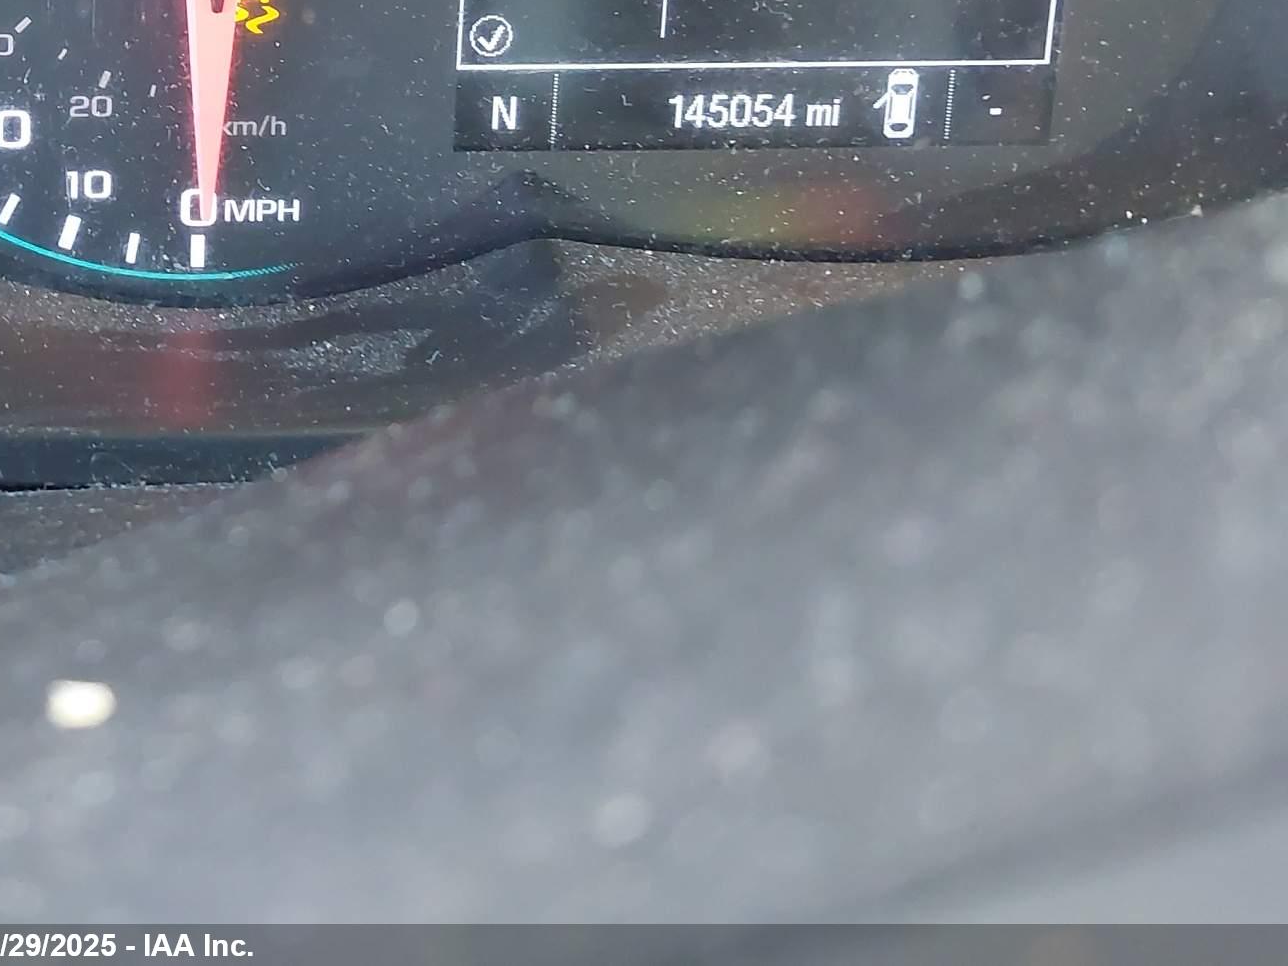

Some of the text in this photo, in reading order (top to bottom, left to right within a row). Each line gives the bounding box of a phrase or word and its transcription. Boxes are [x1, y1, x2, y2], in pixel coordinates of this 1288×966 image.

[69, 95, 113, 118] 20
[492, 96, 517, 132] N
[668, 94, 841, 128] 145054 mi
[66, 170, 112, 199] 10
[180, 188, 301, 227] 0 MPH
